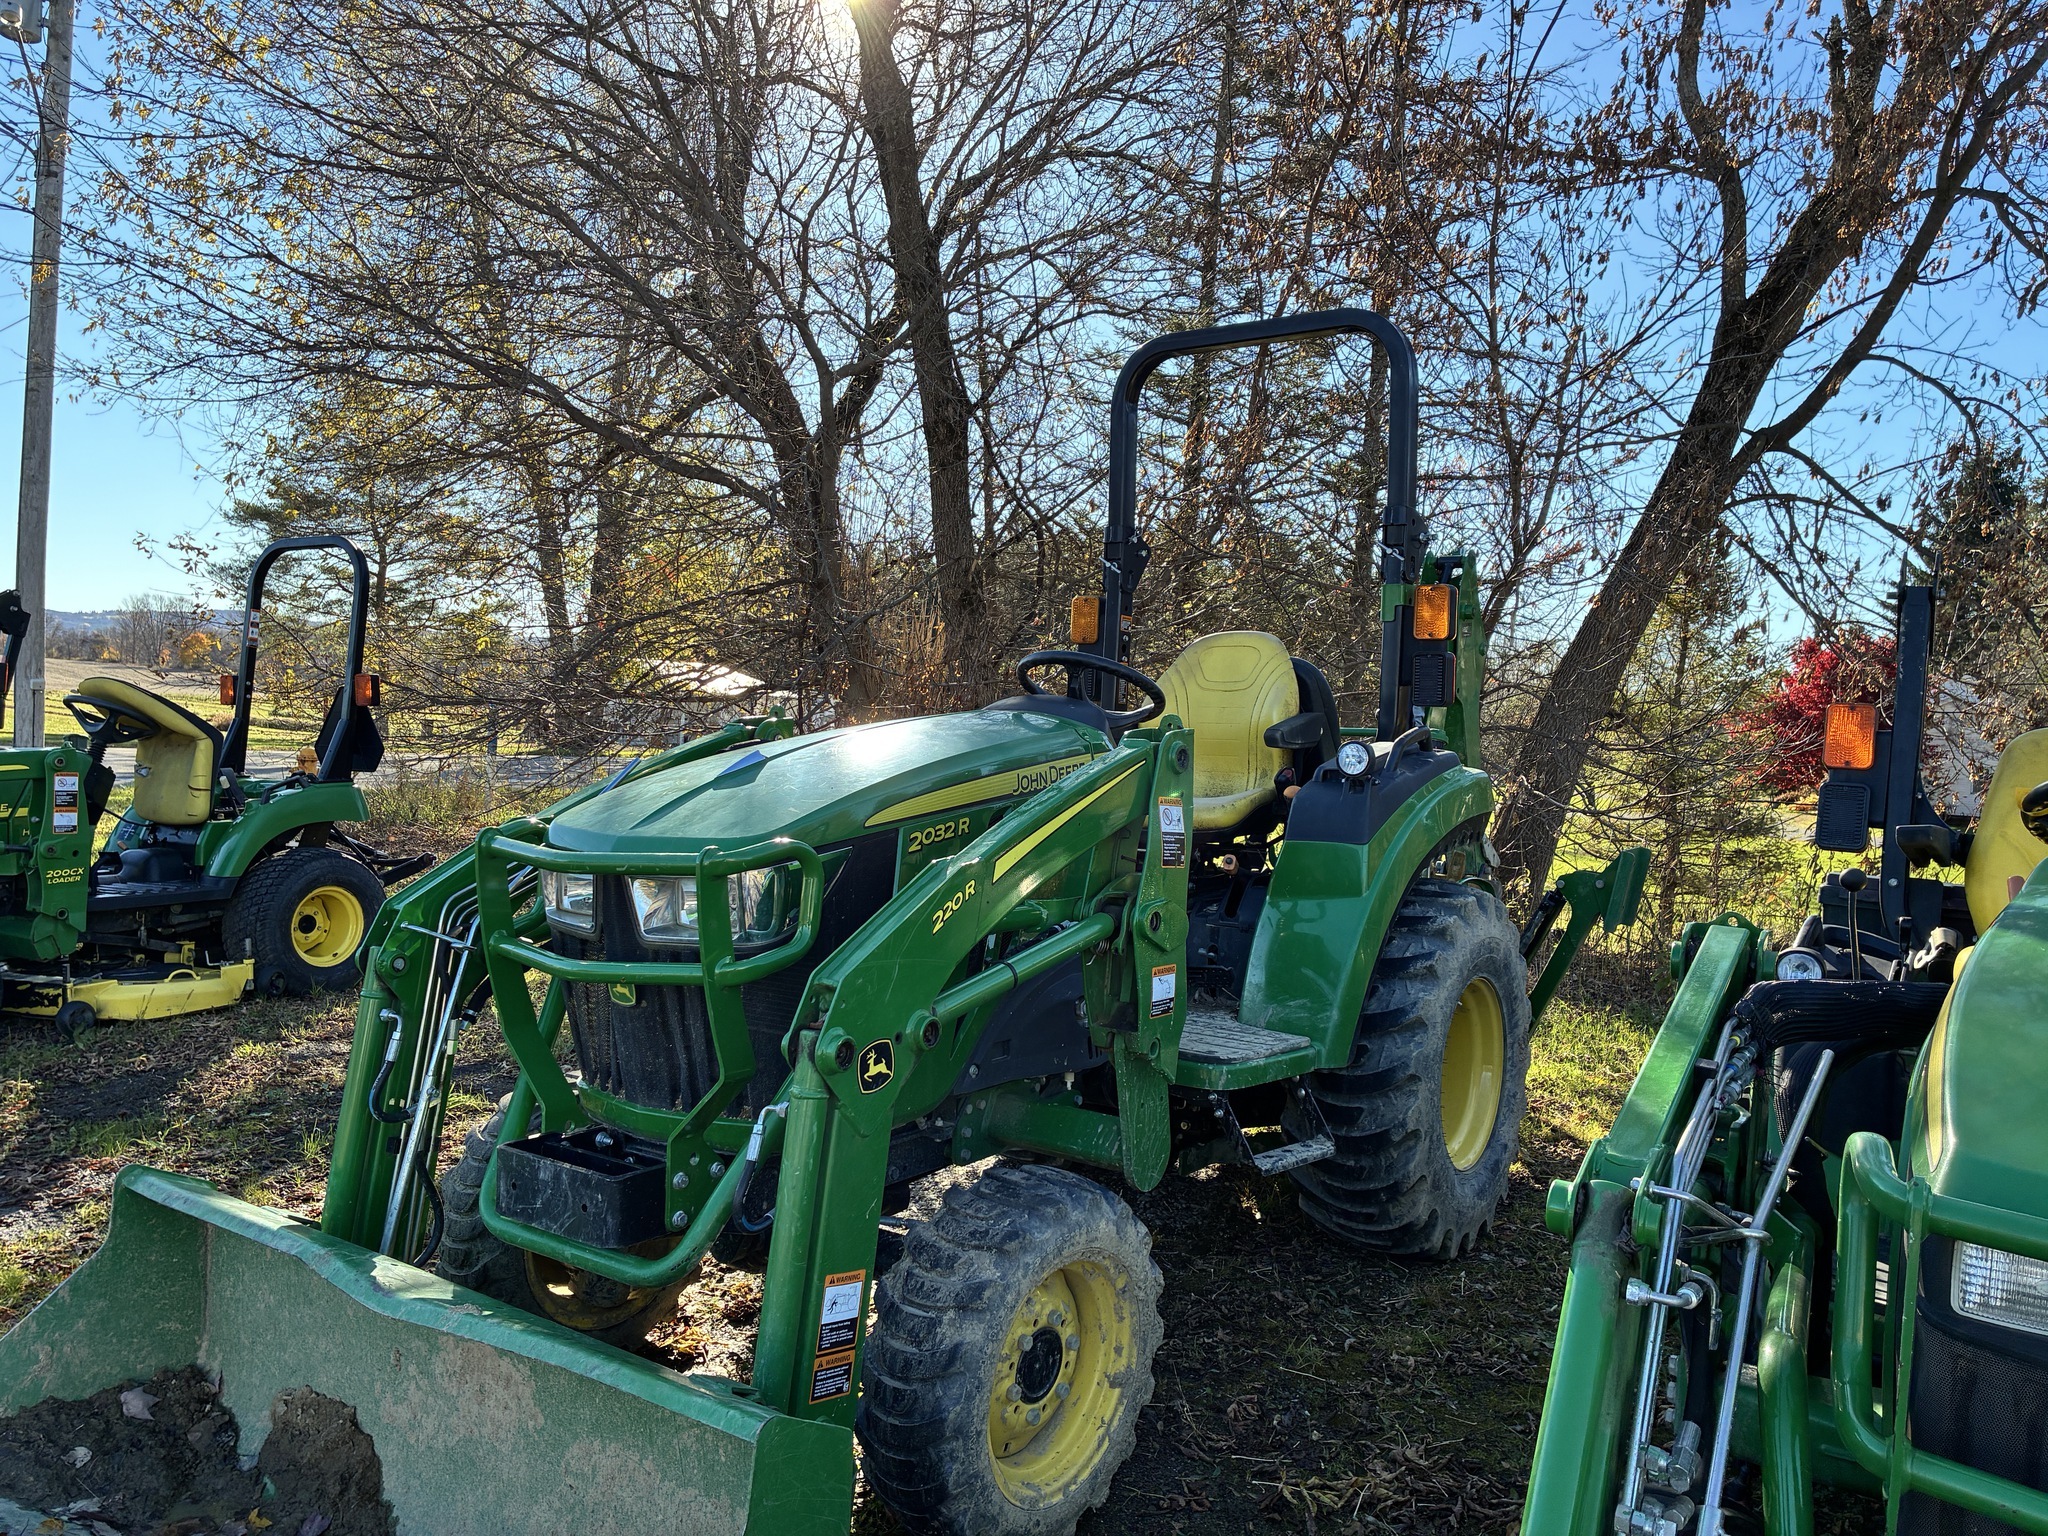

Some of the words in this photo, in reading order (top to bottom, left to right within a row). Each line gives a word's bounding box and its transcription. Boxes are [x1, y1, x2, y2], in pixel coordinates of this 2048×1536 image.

[1013, 771, 1048, 794] JOHN
[908, 821, 956, 853] 2032
[958, 818, 970, 836] R
[46, 867, 84, 878] 200CX
[48, 876, 81, 885] LOADER
[932, 891, 963, 935] 220
[965, 879, 976, 901] R
[836, 1273, 861, 1283] WARNING
[825, 1354, 851, 1366] WARNING
